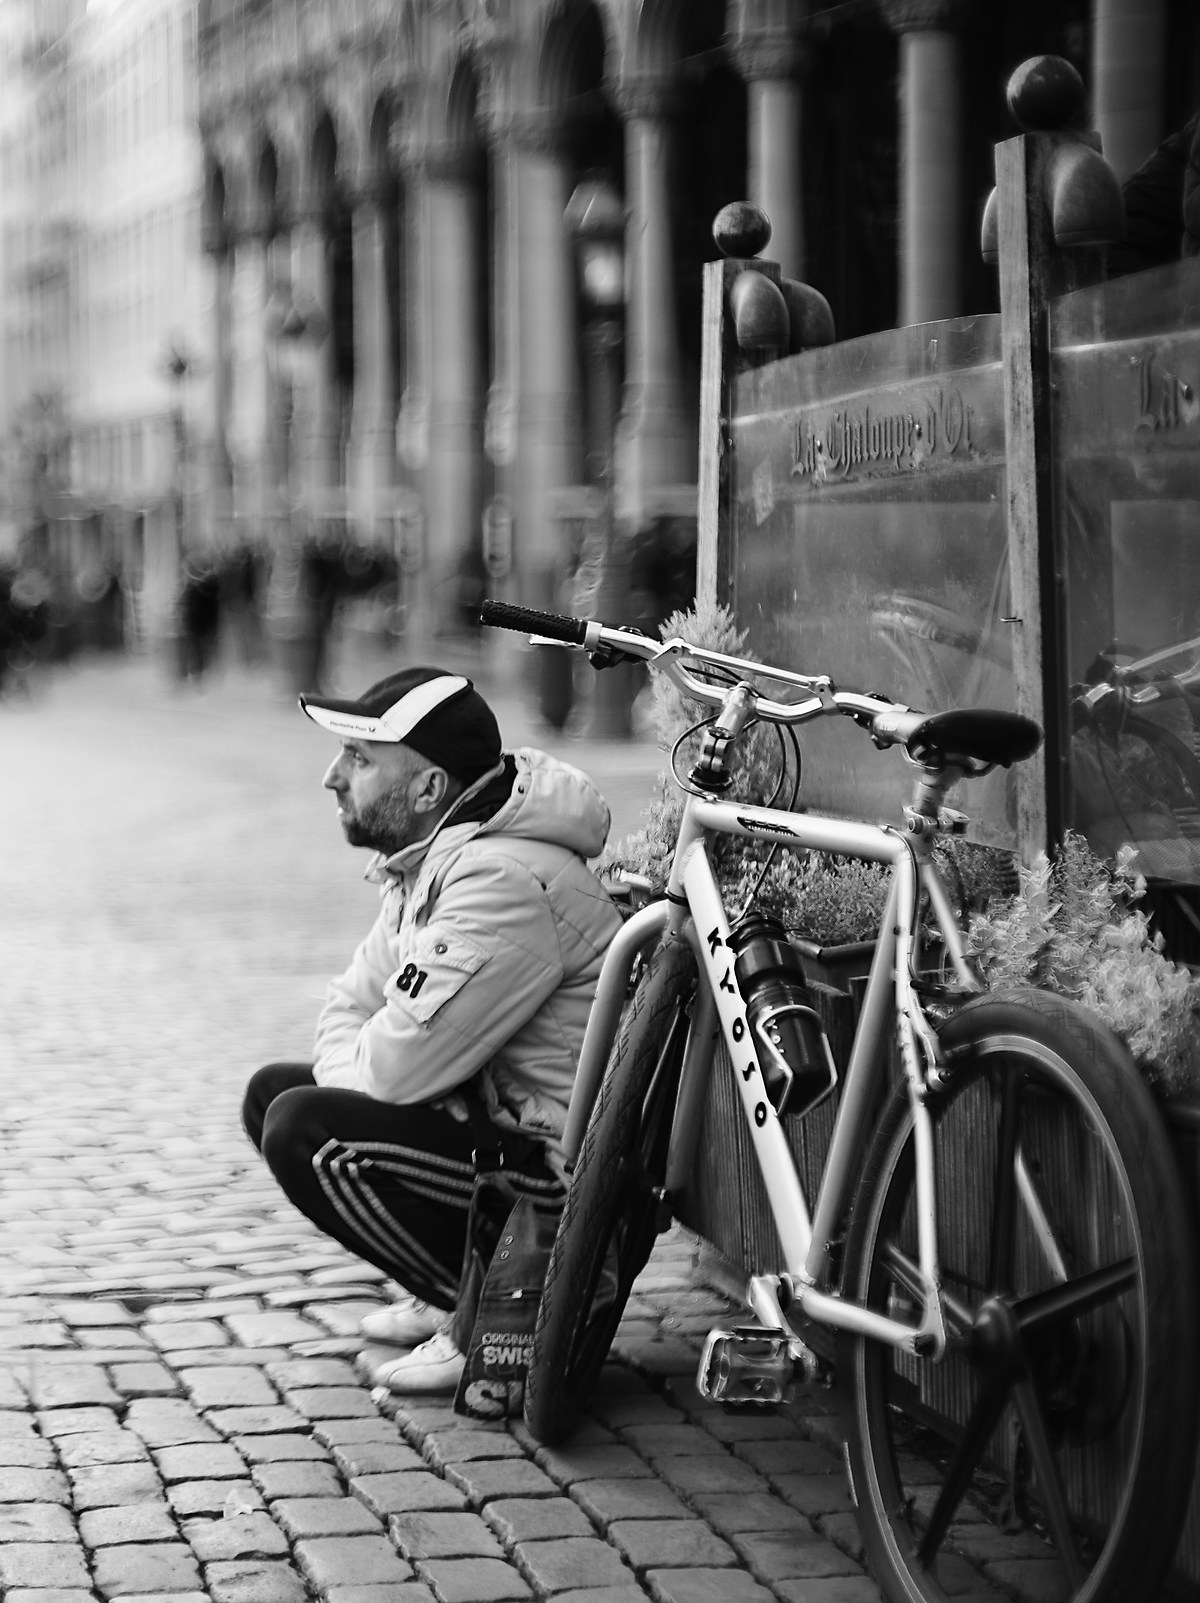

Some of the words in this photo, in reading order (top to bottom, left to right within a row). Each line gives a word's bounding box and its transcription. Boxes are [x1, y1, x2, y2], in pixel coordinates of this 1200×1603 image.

[791, 420, 816, 476] La
[827, 404, 916, 475] Chaloupe
[396, 962, 428, 999] 81
[707, 926, 767, 1128] KYOSO
